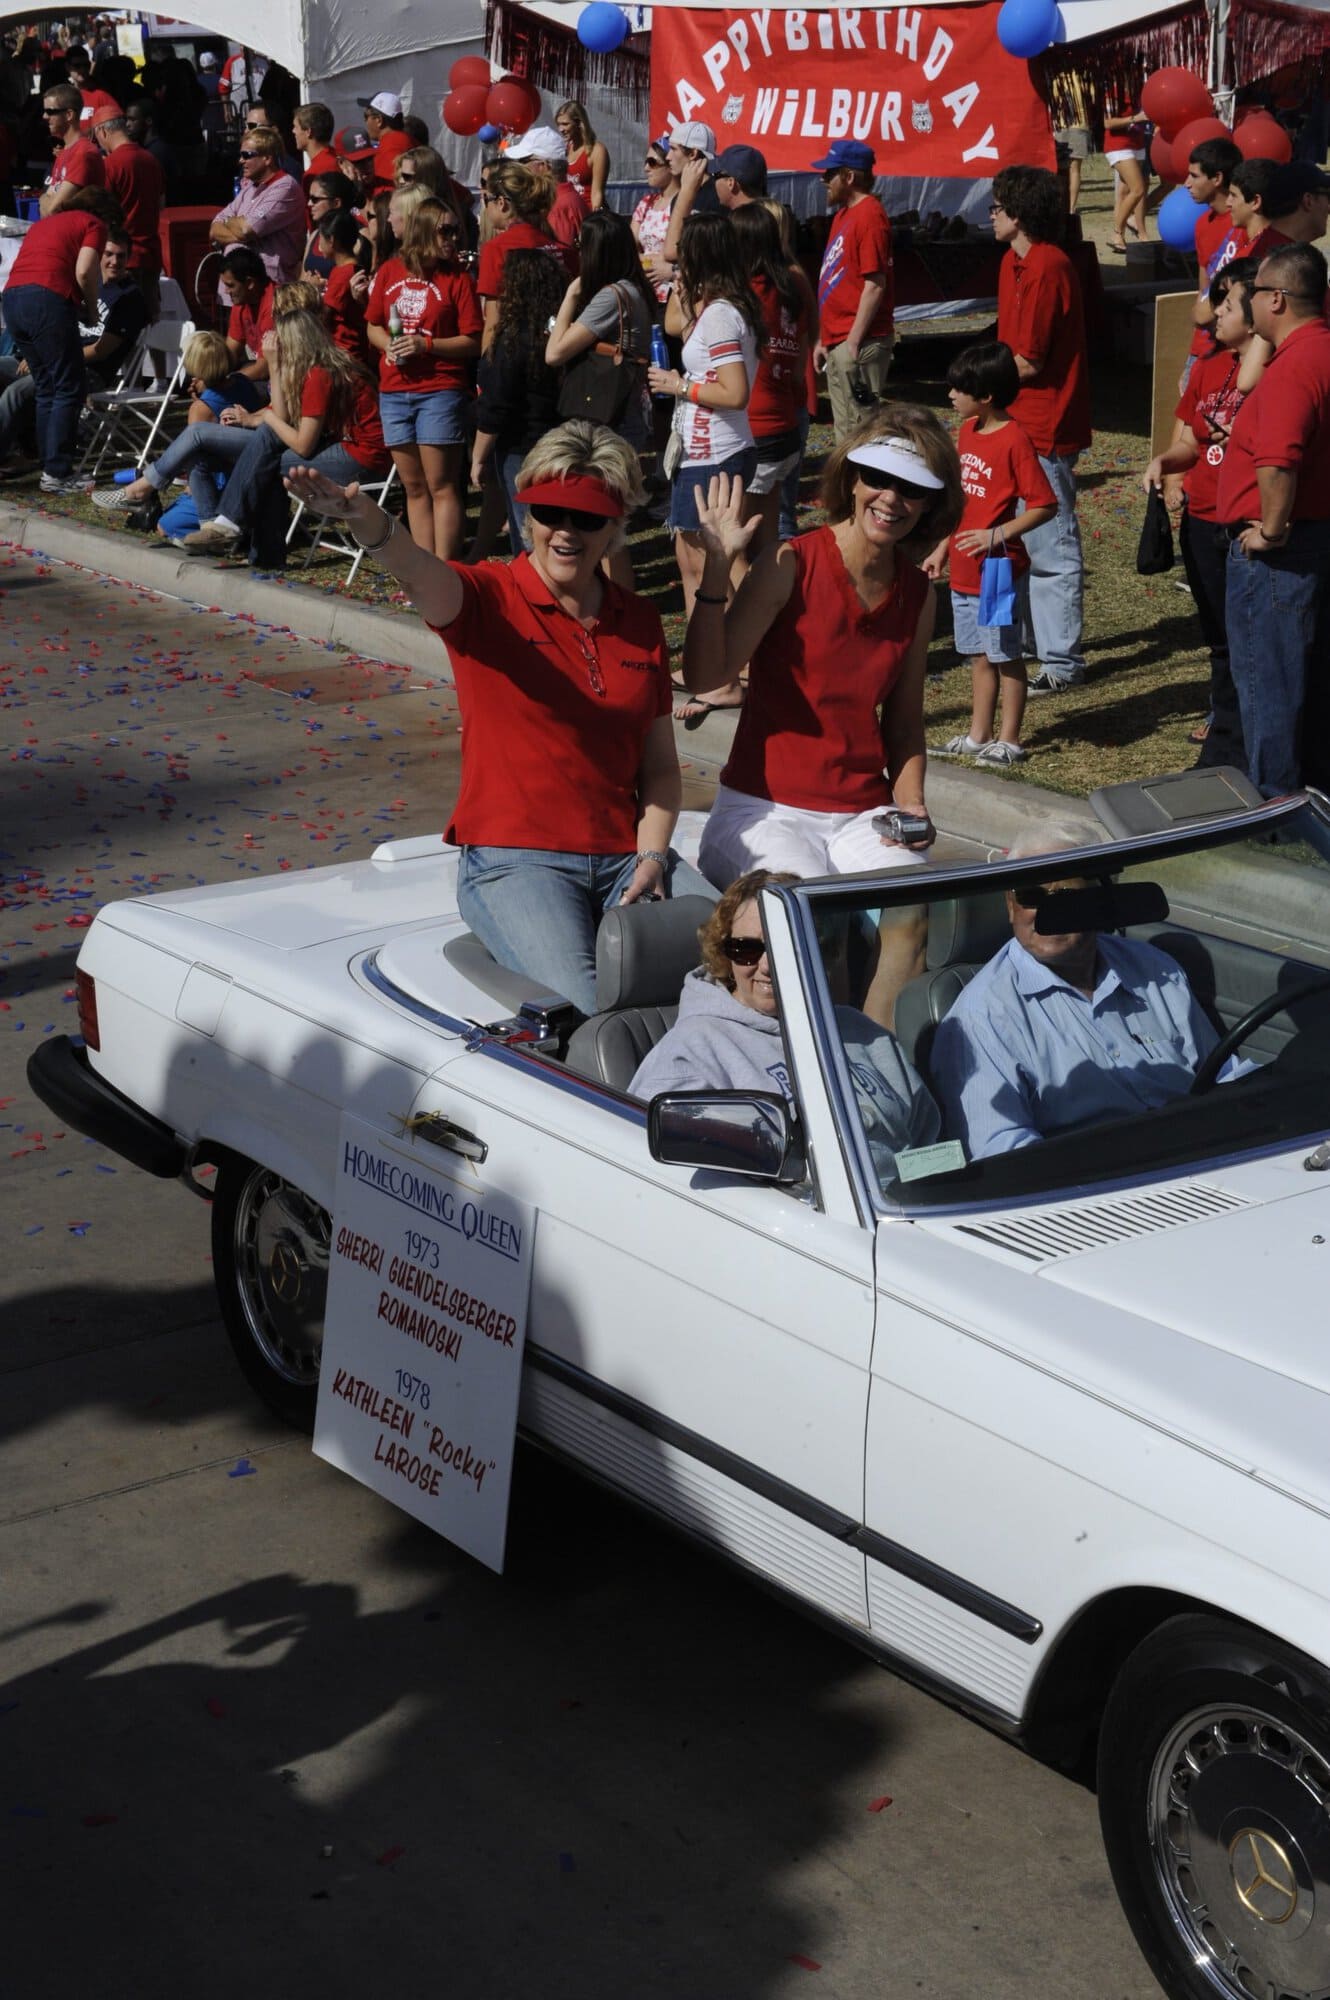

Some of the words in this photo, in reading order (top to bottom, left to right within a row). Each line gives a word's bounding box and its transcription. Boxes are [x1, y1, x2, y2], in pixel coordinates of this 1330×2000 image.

[343, 1141, 454, 1222] HOMECOMING
[461, 1202, 522, 1256] QUEEN
[404, 1229, 440, 1270] 1973
[336, 1226, 385, 1276] SHERRI
[388, 1255, 517, 1348] GUENDELSBERGER
[377, 1290, 463, 1363] ROMANOSKI
[332, 1367, 416, 1439] KATHLEEN
[395, 1368, 431, 1410] 1978
[374, 1433, 443, 1497] LAROSE
